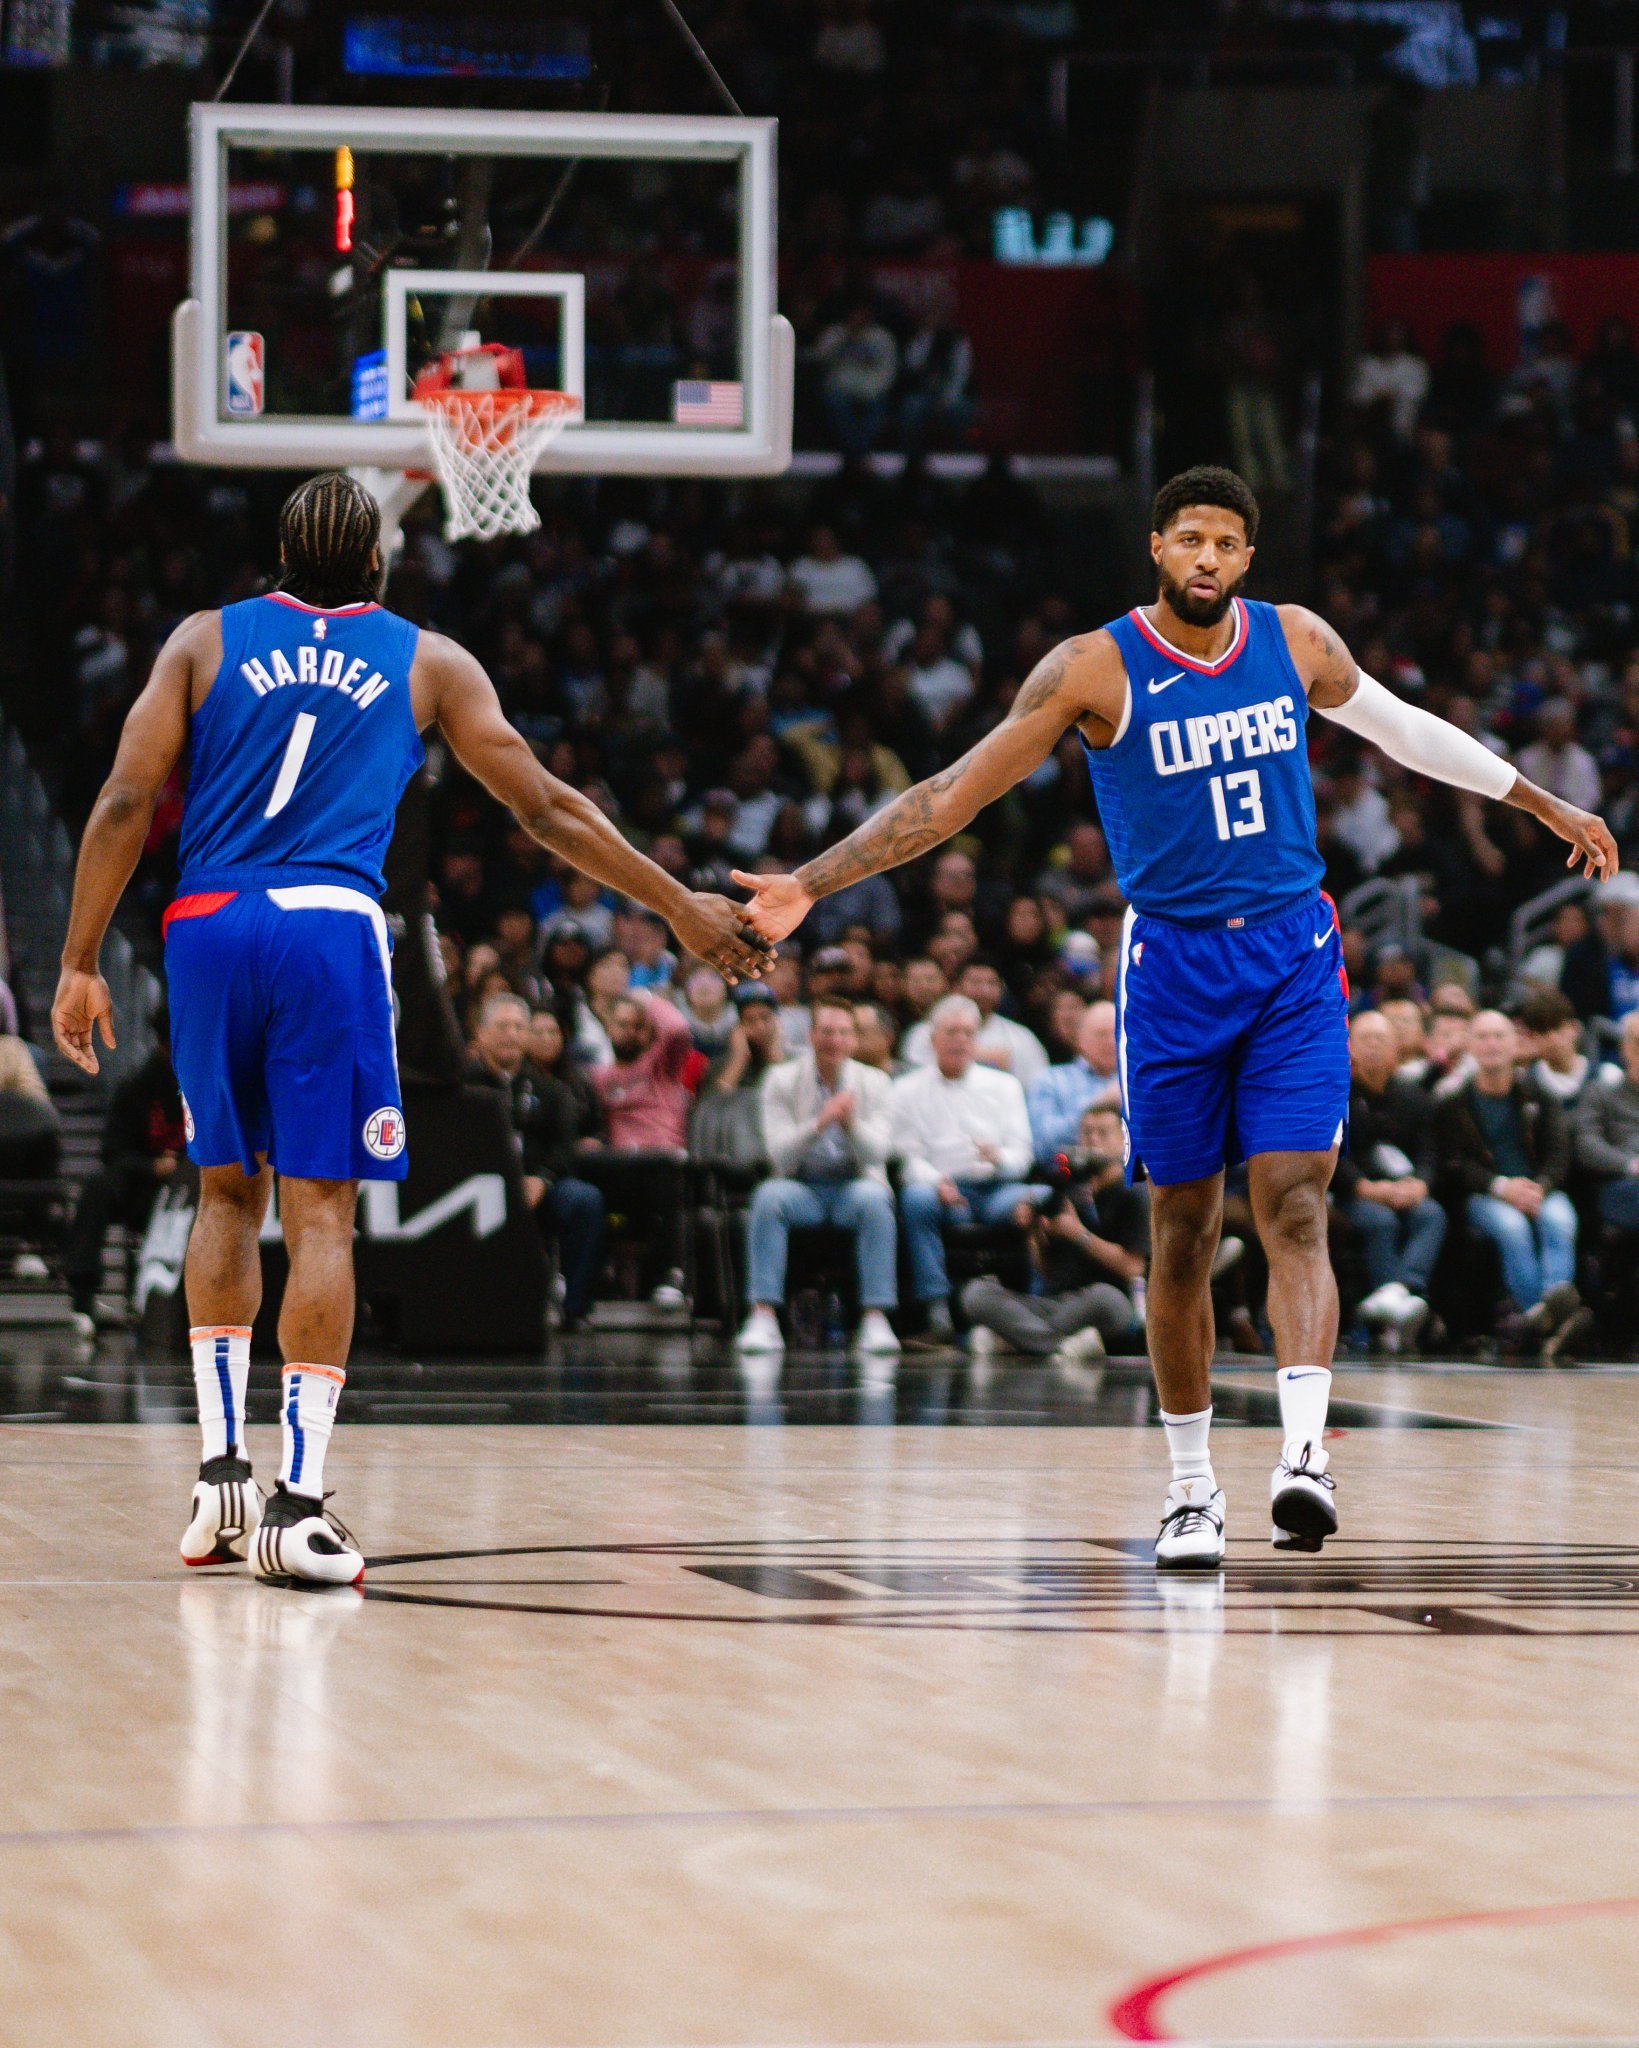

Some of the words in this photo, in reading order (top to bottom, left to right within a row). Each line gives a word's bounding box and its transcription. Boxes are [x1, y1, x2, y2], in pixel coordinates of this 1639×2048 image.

[240, 646, 390, 711] HARDEN
[263, 711, 317, 820] 1
[1149, 695, 1297, 776] CLIPPERS
[1209, 769, 1266, 841] 13
